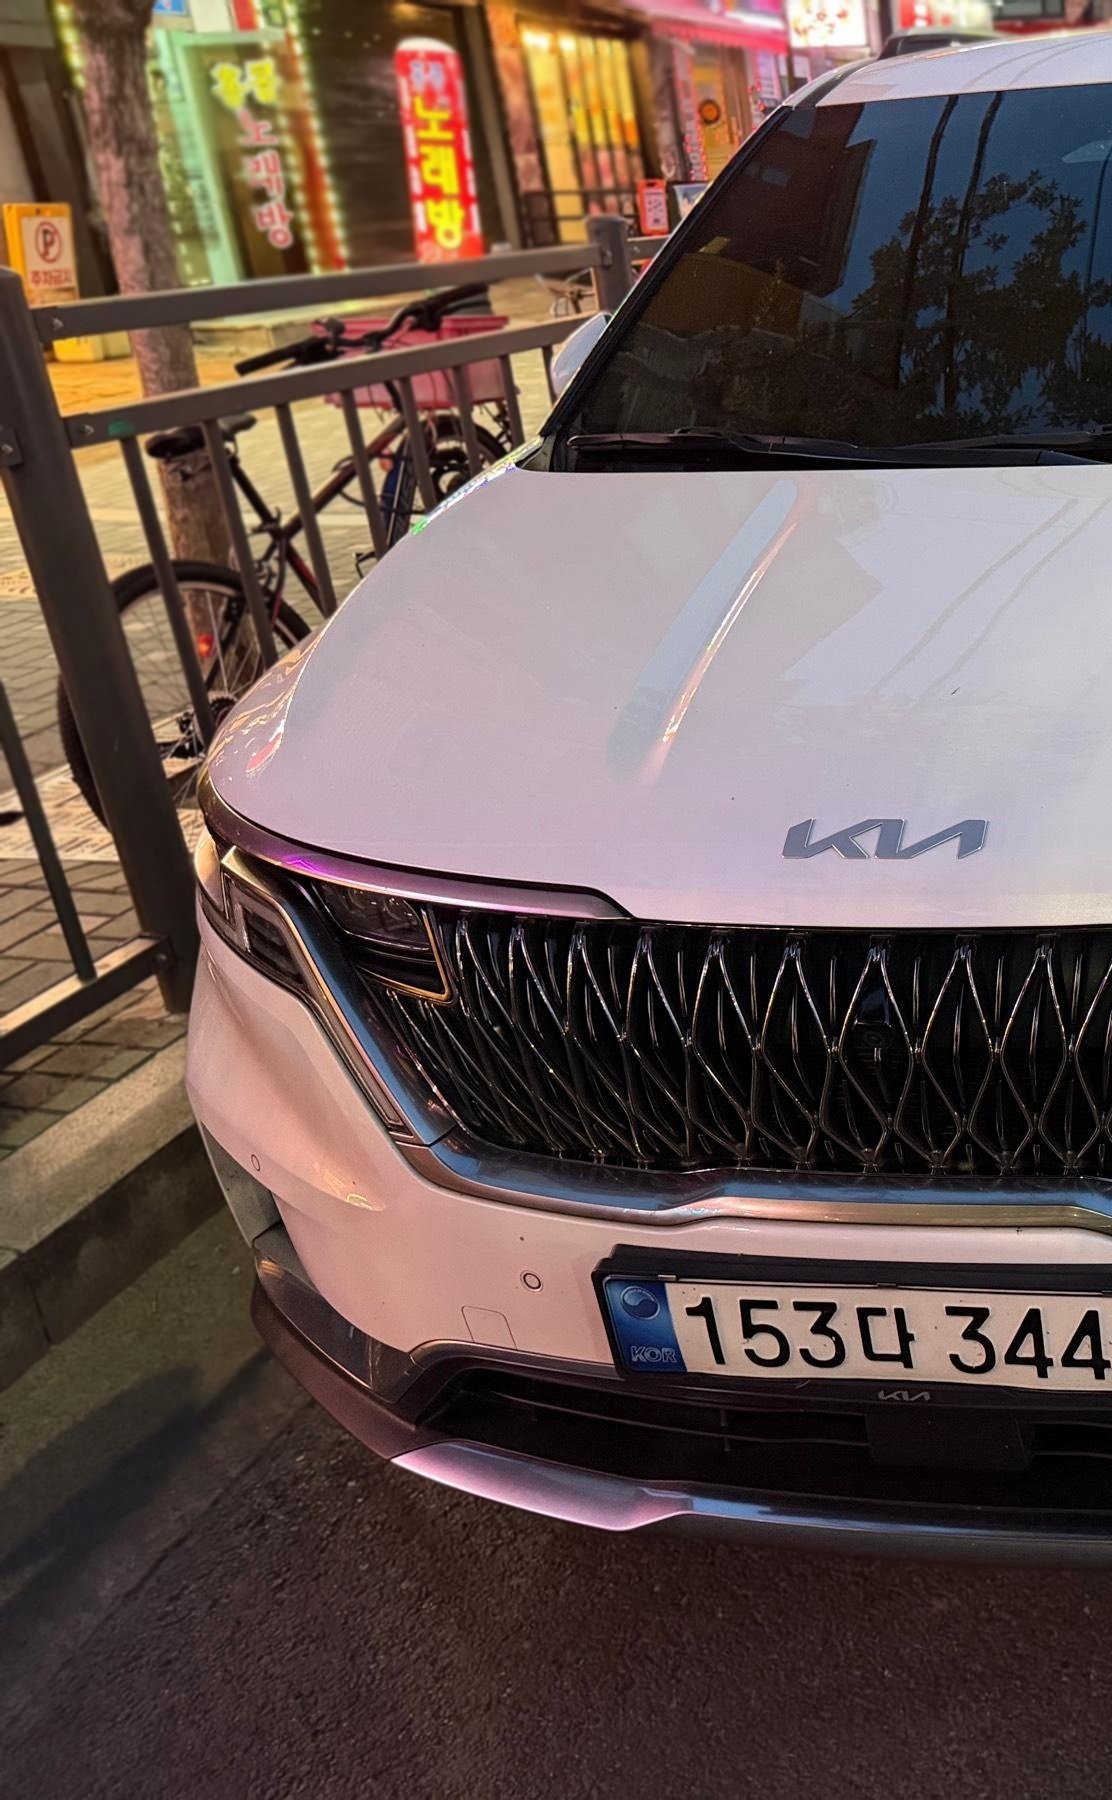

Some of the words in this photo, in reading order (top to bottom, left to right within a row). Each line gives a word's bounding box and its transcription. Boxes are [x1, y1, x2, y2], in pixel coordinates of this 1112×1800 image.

[236, 108, 294, 249] 노래방
[413, 95, 465, 249] 노래방
[631, 1345, 678, 1364] KOR
[685, 1296, 916, 1369] 153다
